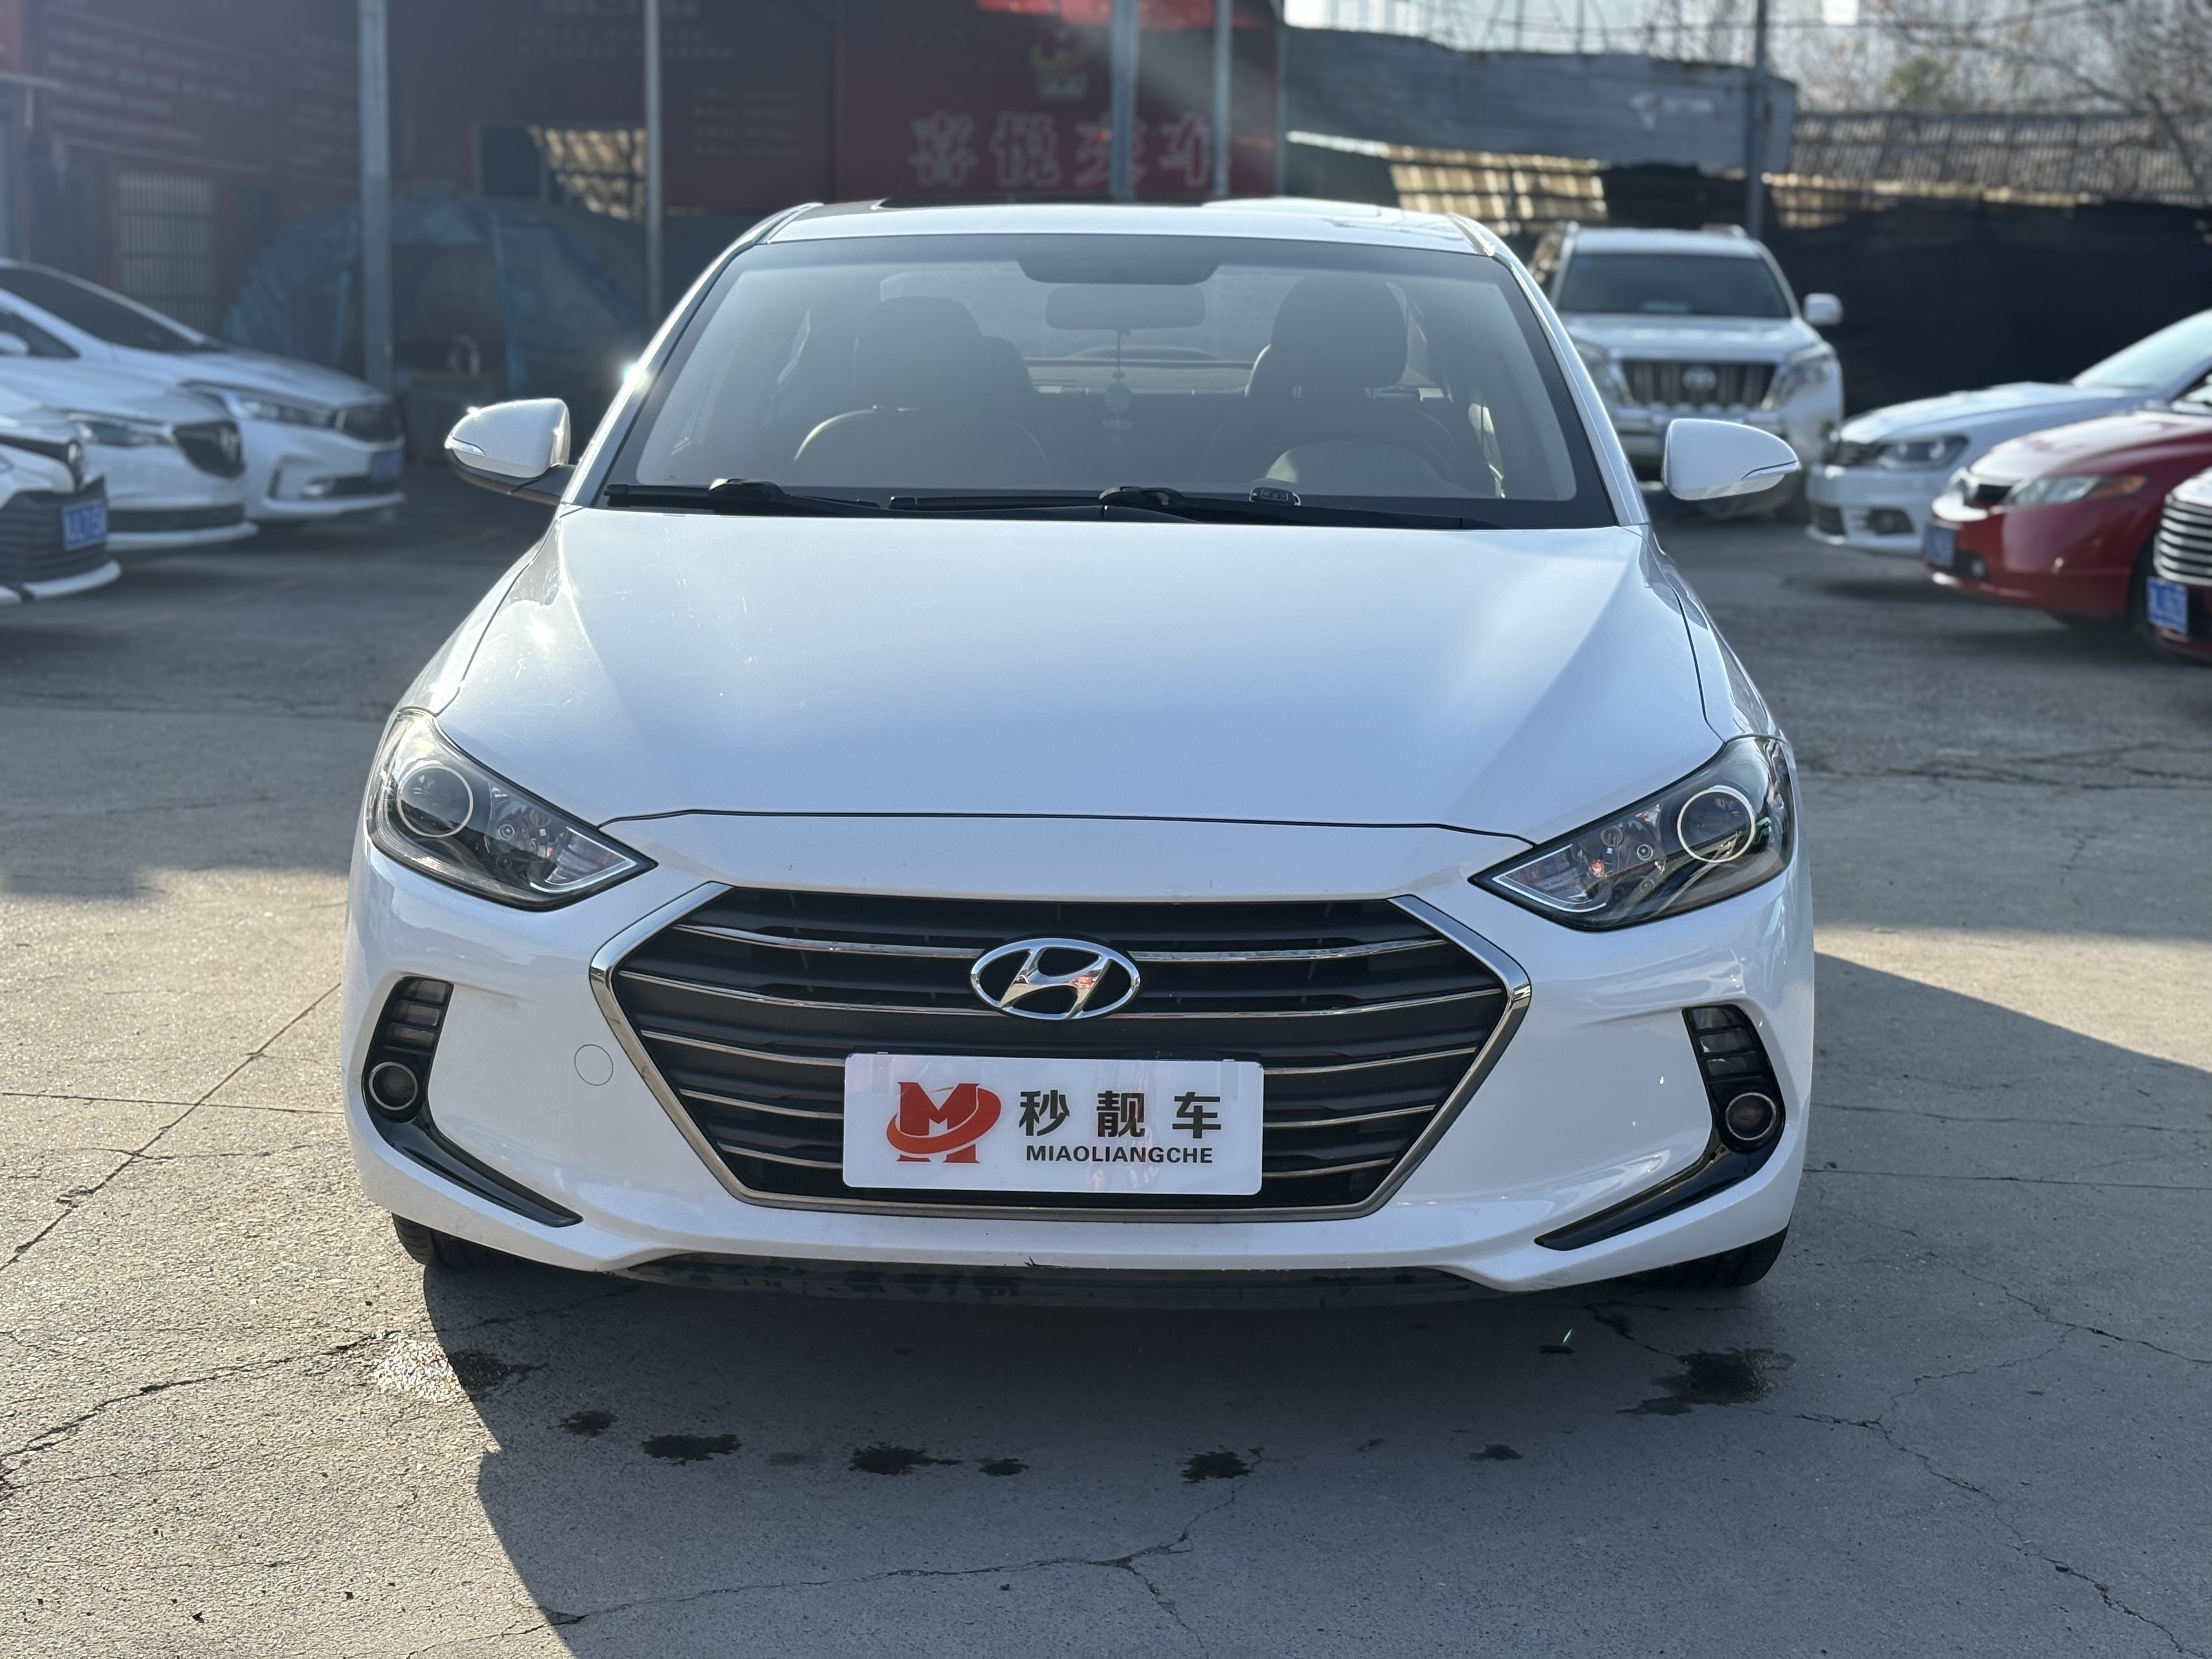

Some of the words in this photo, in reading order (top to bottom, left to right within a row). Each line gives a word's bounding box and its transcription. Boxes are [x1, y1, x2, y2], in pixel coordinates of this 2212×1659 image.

[1019, 1090, 1221, 1139] 秒靓车
[1026, 1145, 1213, 1164] MIAOLIANGCHE
